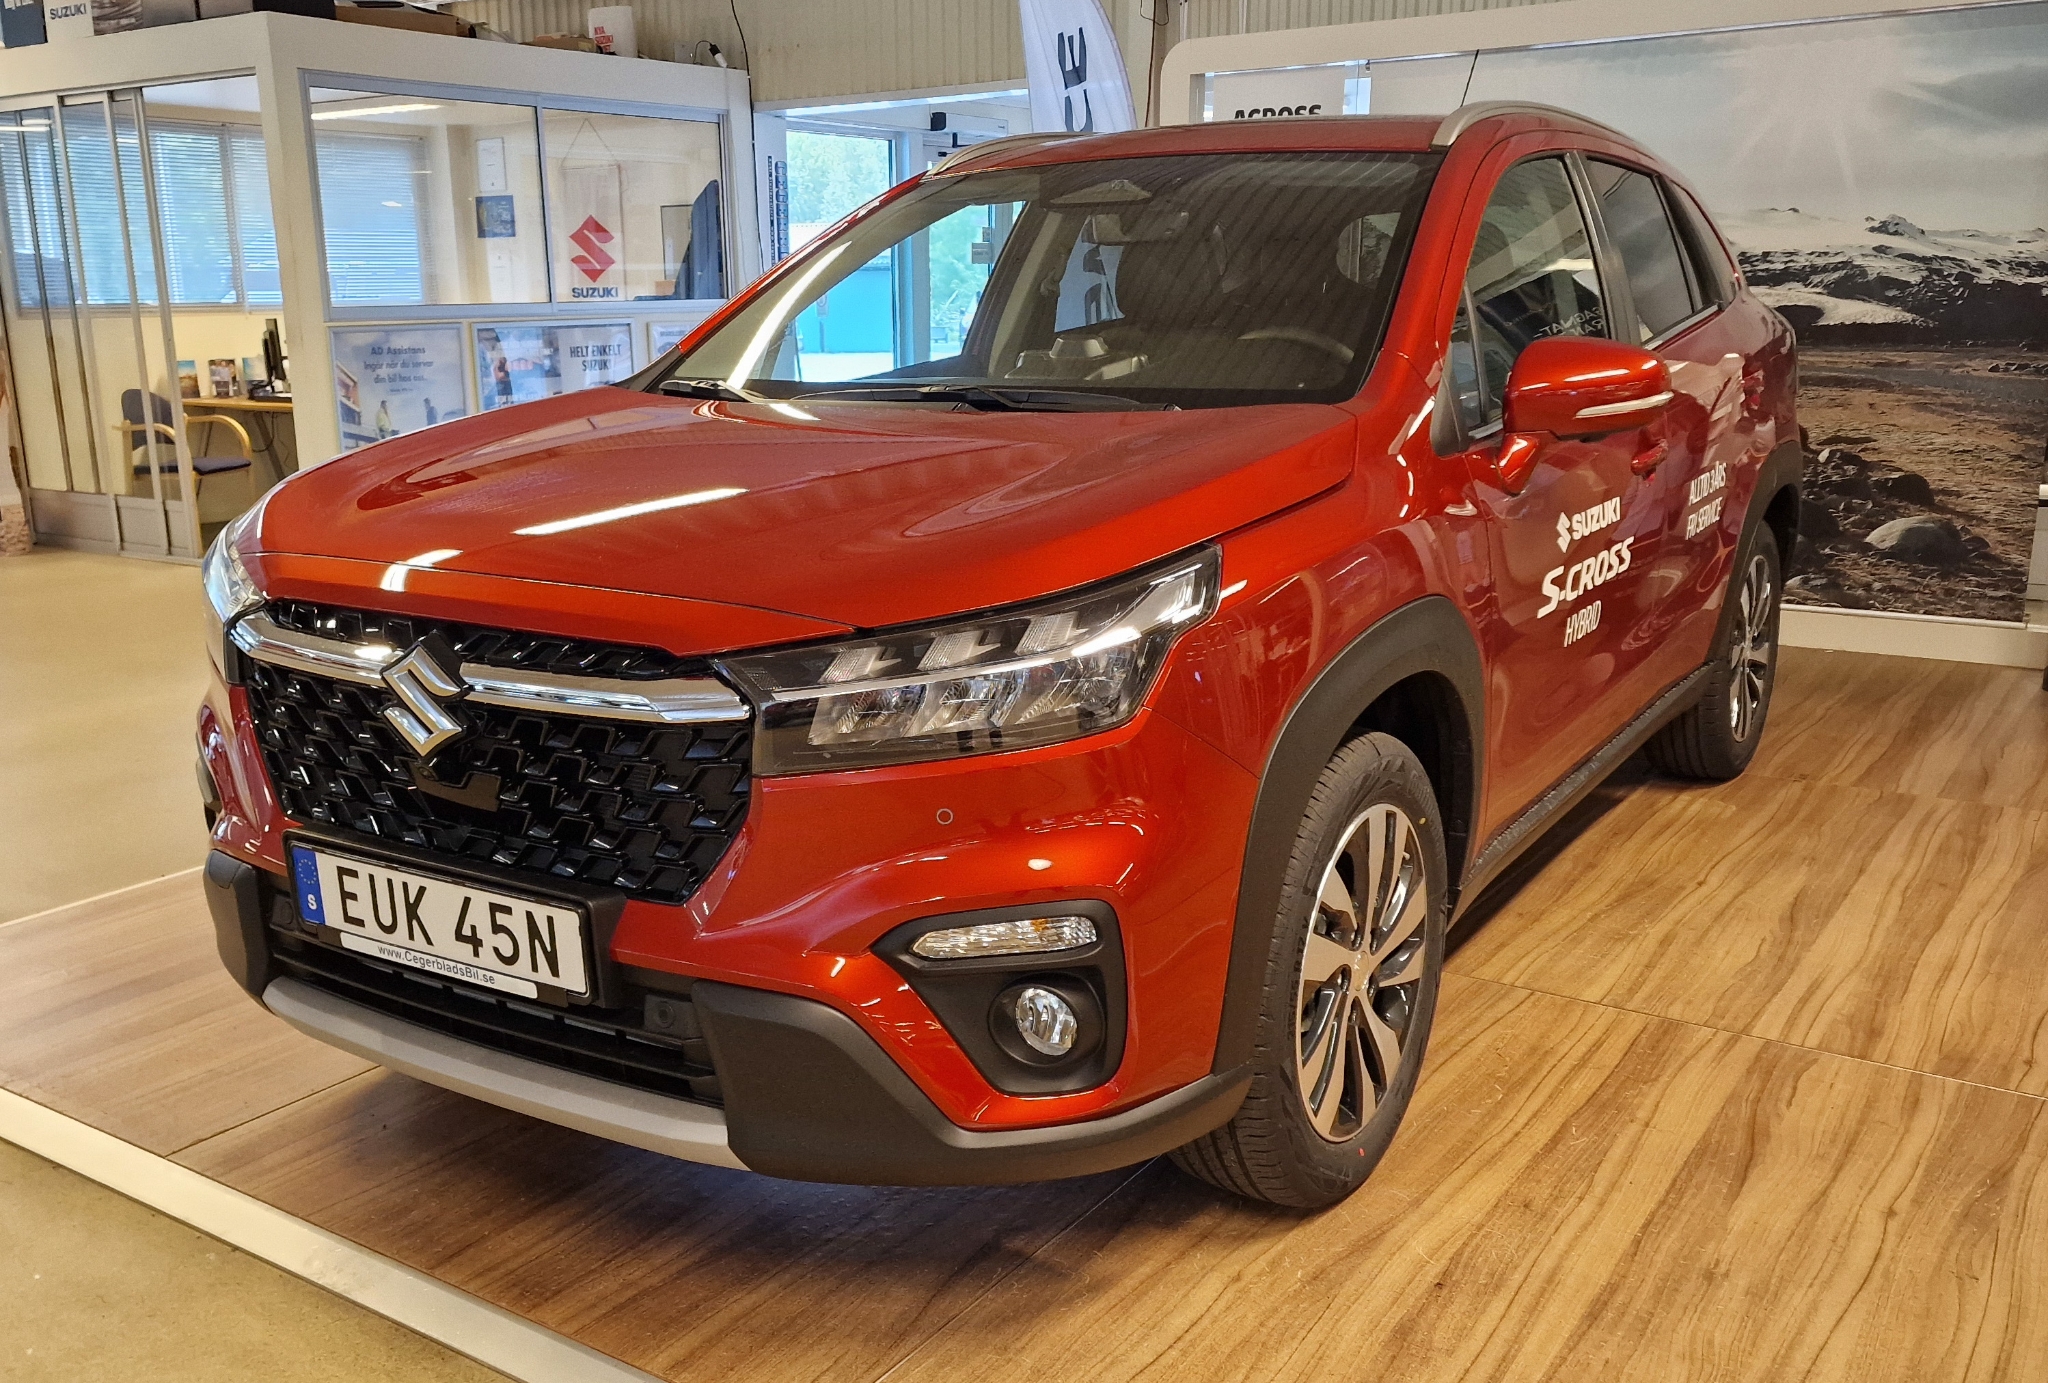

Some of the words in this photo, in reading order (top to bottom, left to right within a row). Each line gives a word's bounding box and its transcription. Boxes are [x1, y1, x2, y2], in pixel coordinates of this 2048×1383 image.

[49, 3, 87, 20] SUZUKI
[571, 286, 619, 299] SUZUKI
[371, 346, 384, 355] AD
[386, 345, 426, 355] Assistans
[569, 346, 589, 358] HELT
[591, 344, 622, 356] ENKELT
[1689, 471, 1711, 507] ALLTID
[1571, 496, 1621, 540] SUZUKI
[1696, 496, 1724, 534] SERVICE
[1537, 536, 1635, 619] S-CROSS
[1564, 600, 1602, 648] HYBRID
[306, 893, 318, 911] S
[336, 865, 435, 947] EUK
[454, 895, 560, 979] 45N
[377, 944, 496, 985] www.CegerbladsBil.se
